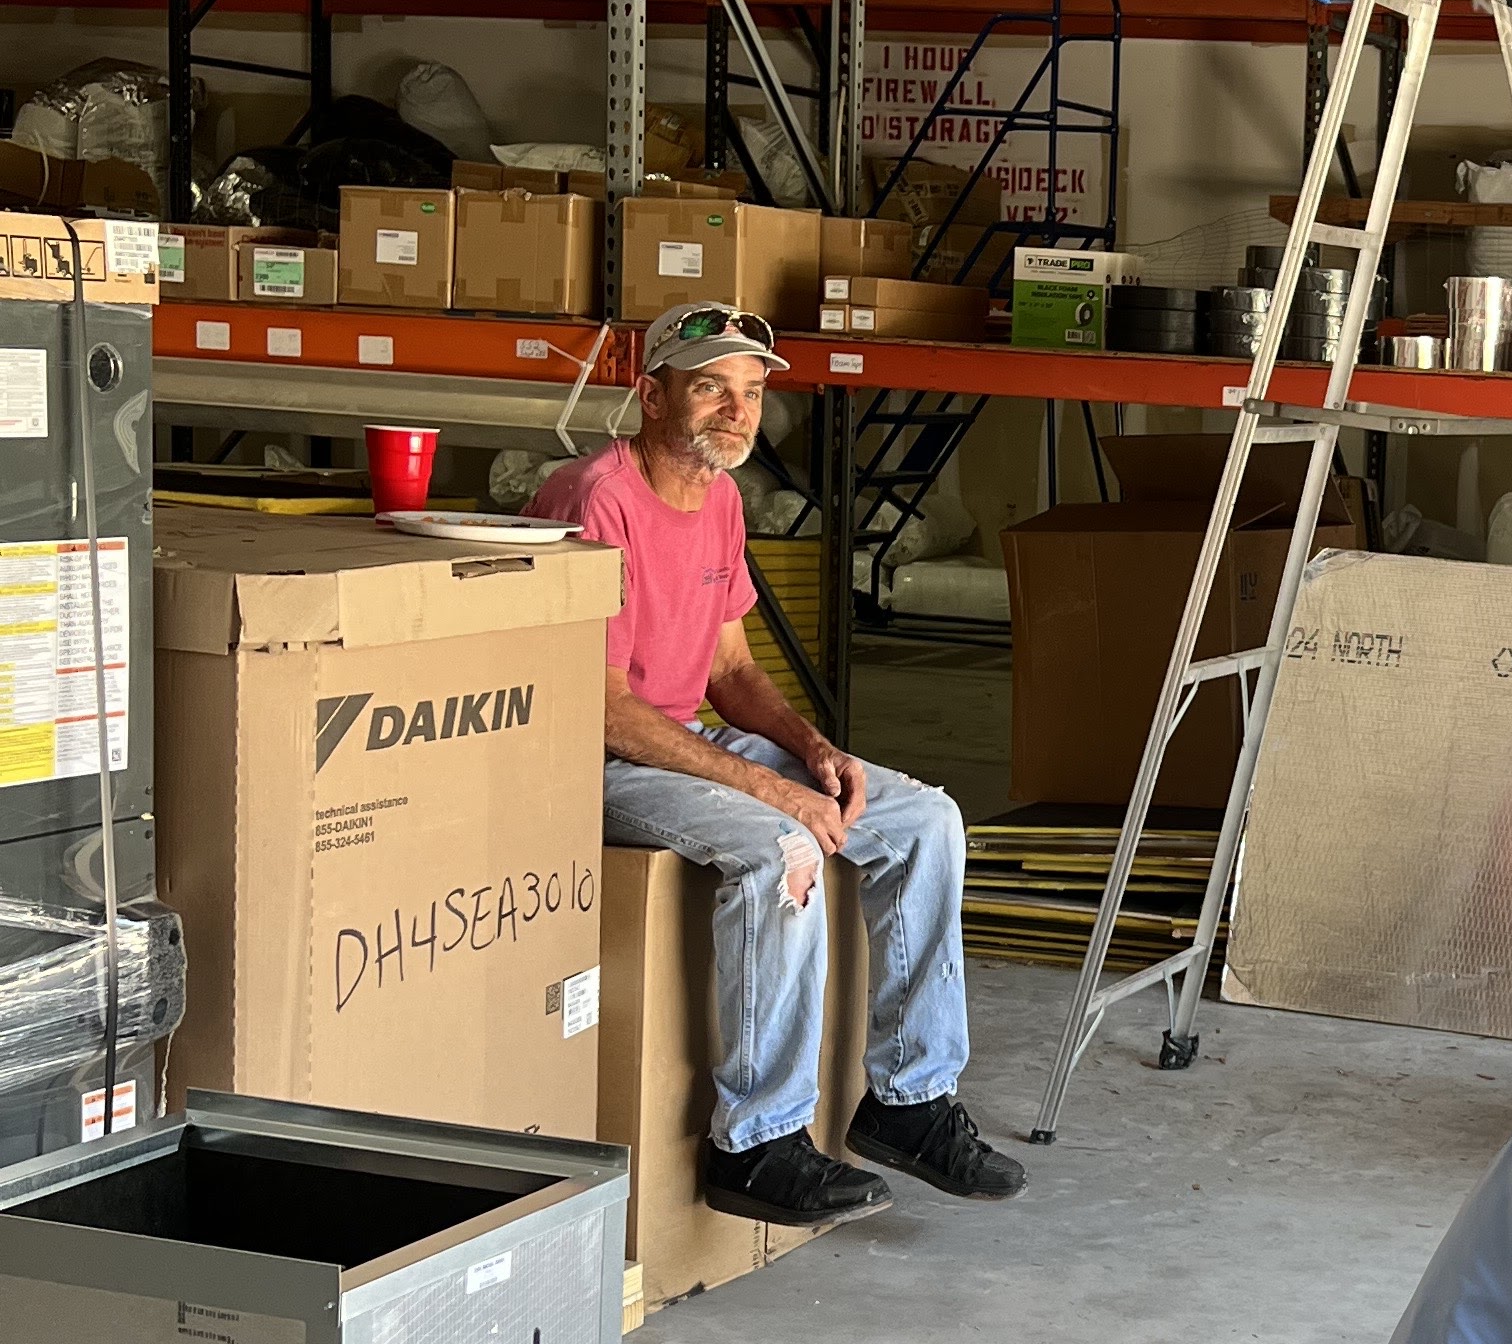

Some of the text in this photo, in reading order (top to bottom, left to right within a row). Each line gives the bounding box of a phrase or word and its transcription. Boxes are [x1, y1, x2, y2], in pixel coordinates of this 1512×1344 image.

[883, 45, 890, 70] 1
[1037, 258, 1091, 269] TRADE PRO
[1331, 632, 1403, 668] NORTH
[365, 684, 534, 751] DAIKIN
[315, 795, 409, 821] technical assistance
[315, 816, 373, 837] 855-DAIKIN1
